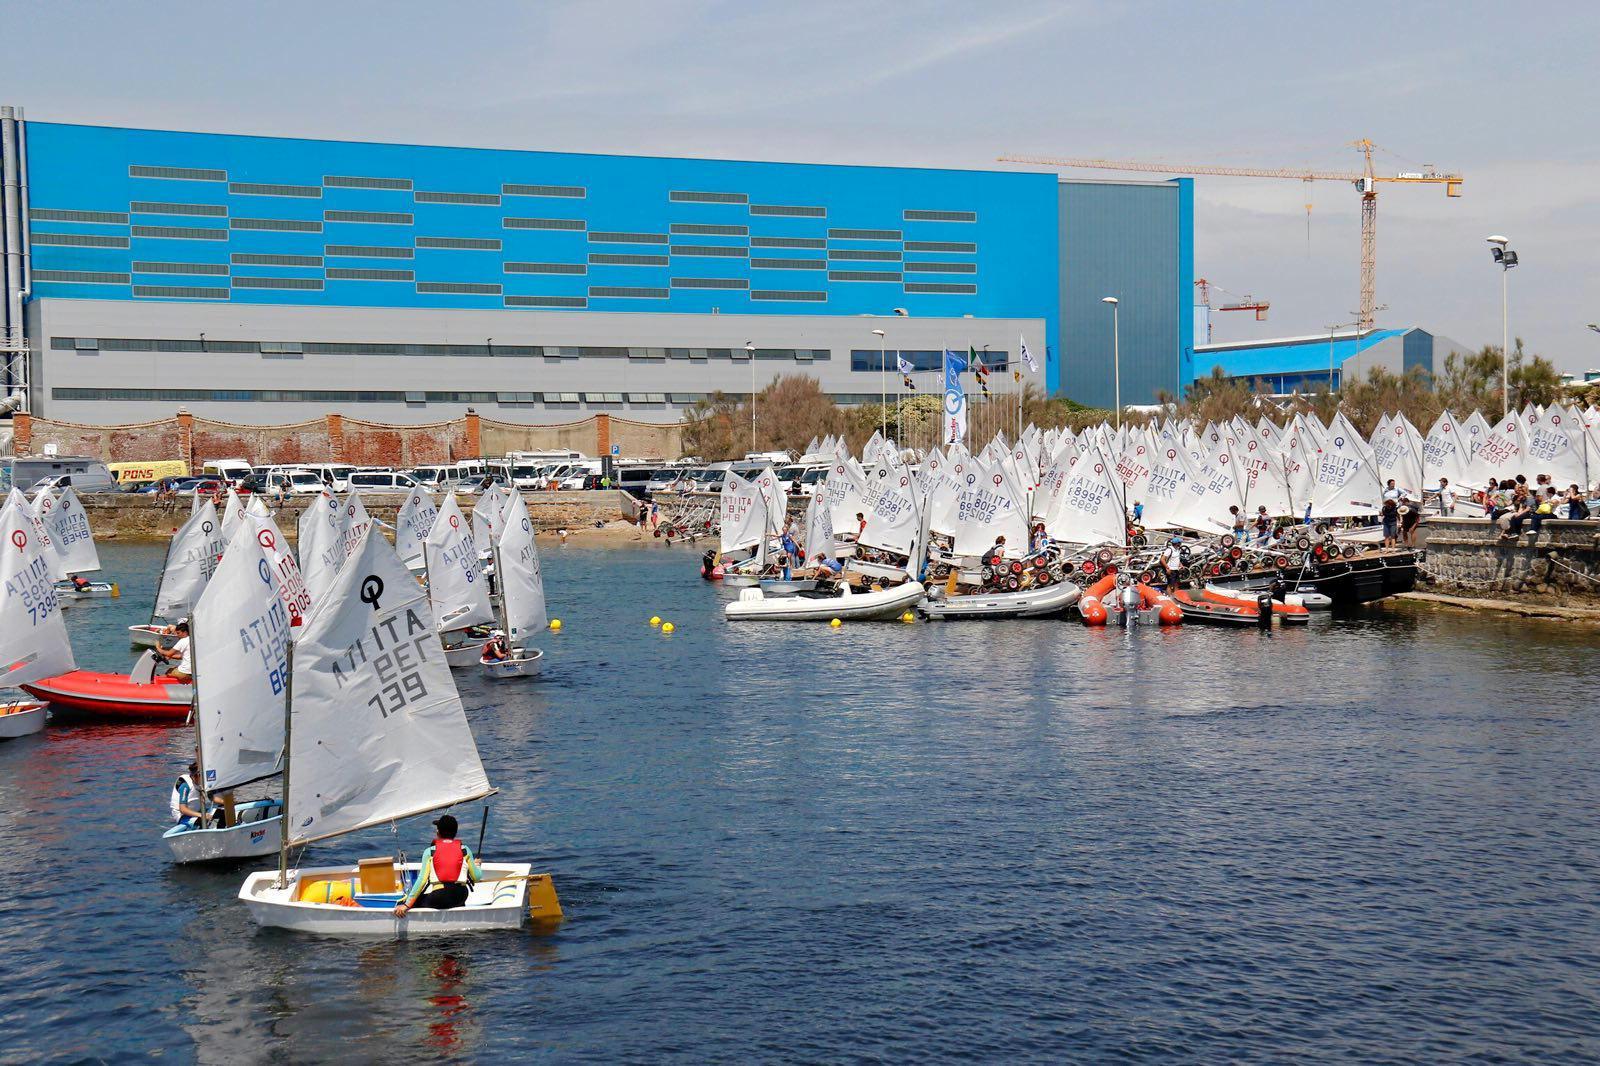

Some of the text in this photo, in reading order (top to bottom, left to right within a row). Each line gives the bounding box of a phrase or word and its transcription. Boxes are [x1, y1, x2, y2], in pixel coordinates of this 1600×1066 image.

[1424, 443, 1448, 458] 8987
[1484, 441, 1509, 459] 7023
[1533, 438, 1556, 452] 8313
[122, 469, 154, 480] PONS
[1115, 464, 1138, 481] 9087
[1321, 463, 1346, 477] 5513
[1151, 474, 1176, 489] 7776
[1074, 487, 1102, 505] 8995
[880, 498, 901, 515] 6381
[975, 498, 996, 514] 8012
[63, 530, 89, 545] 8349
[28, 590, 57, 626] 7395
[288, 589, 312, 618] 8105
[368, 672, 428, 718] 739
